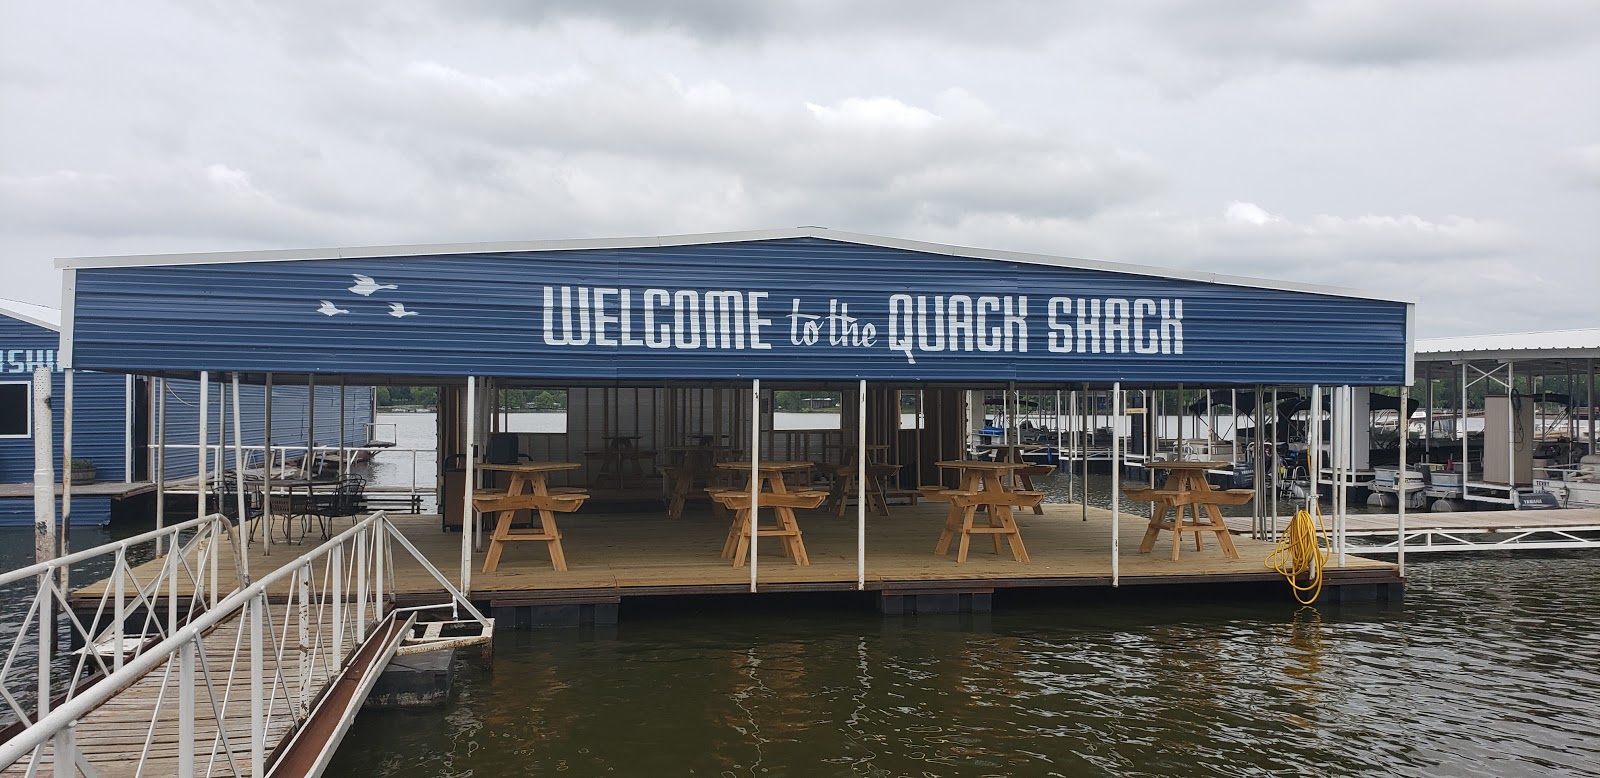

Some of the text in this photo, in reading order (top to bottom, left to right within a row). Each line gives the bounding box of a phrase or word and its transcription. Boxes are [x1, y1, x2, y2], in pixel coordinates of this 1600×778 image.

[543, 286, 1184, 363] WELCOME to the QUACK SHACK
